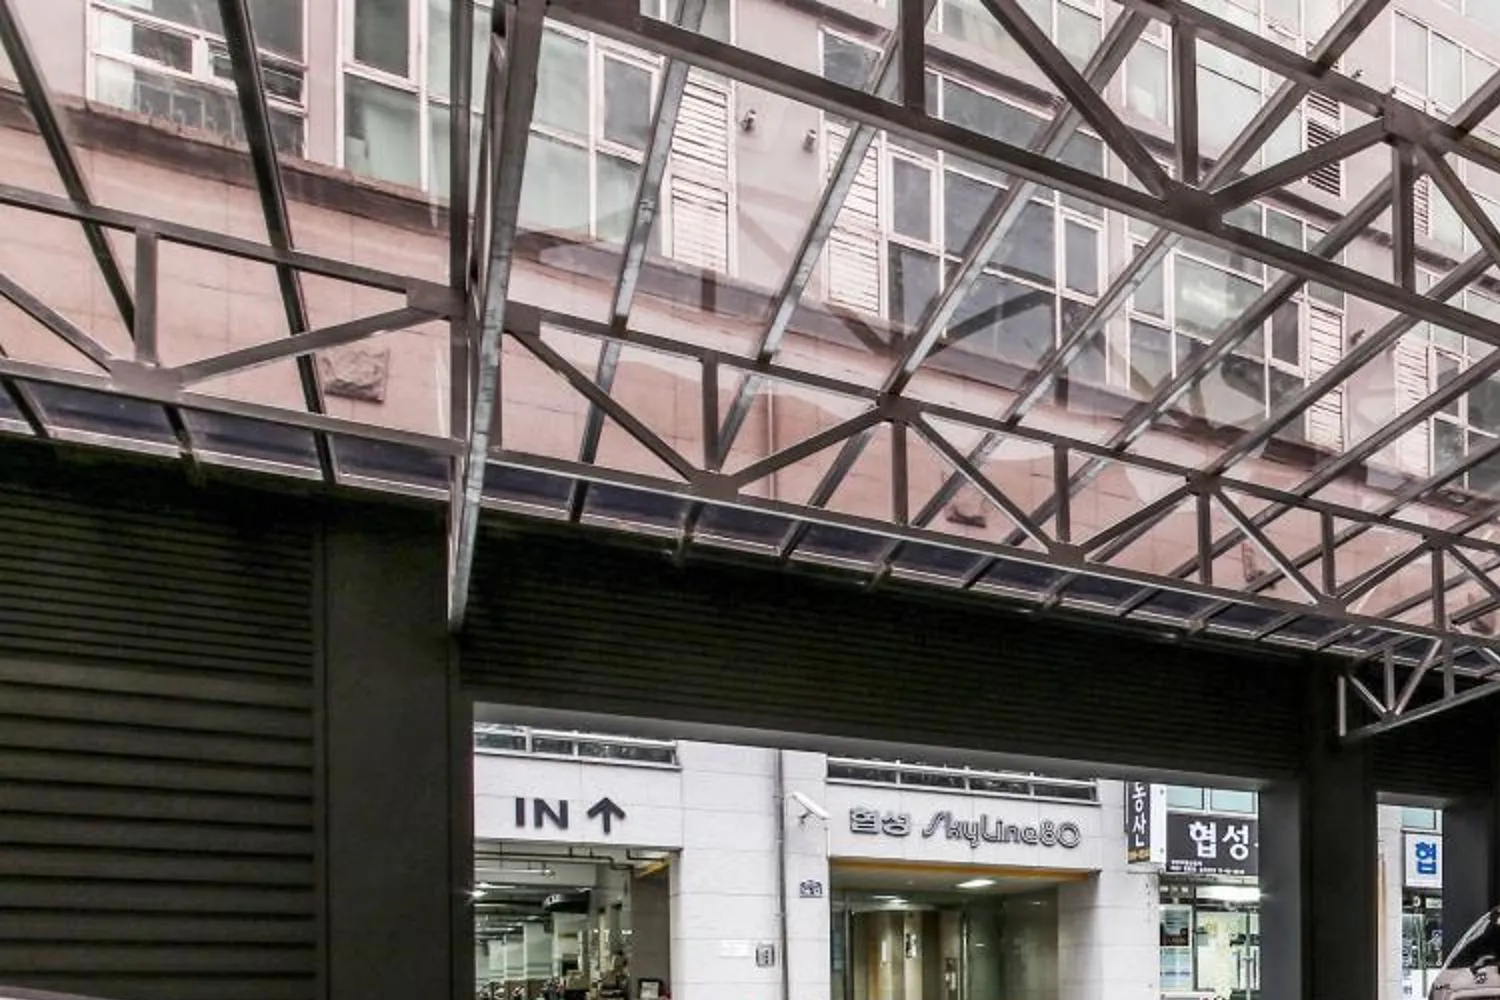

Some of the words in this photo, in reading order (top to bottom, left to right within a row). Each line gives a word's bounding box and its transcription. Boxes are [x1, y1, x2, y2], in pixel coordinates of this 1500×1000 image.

[515, 797, 569, 830] IN
[1188, 821, 1259, 861] 협성
[1415, 841, 1437, 875] 협
